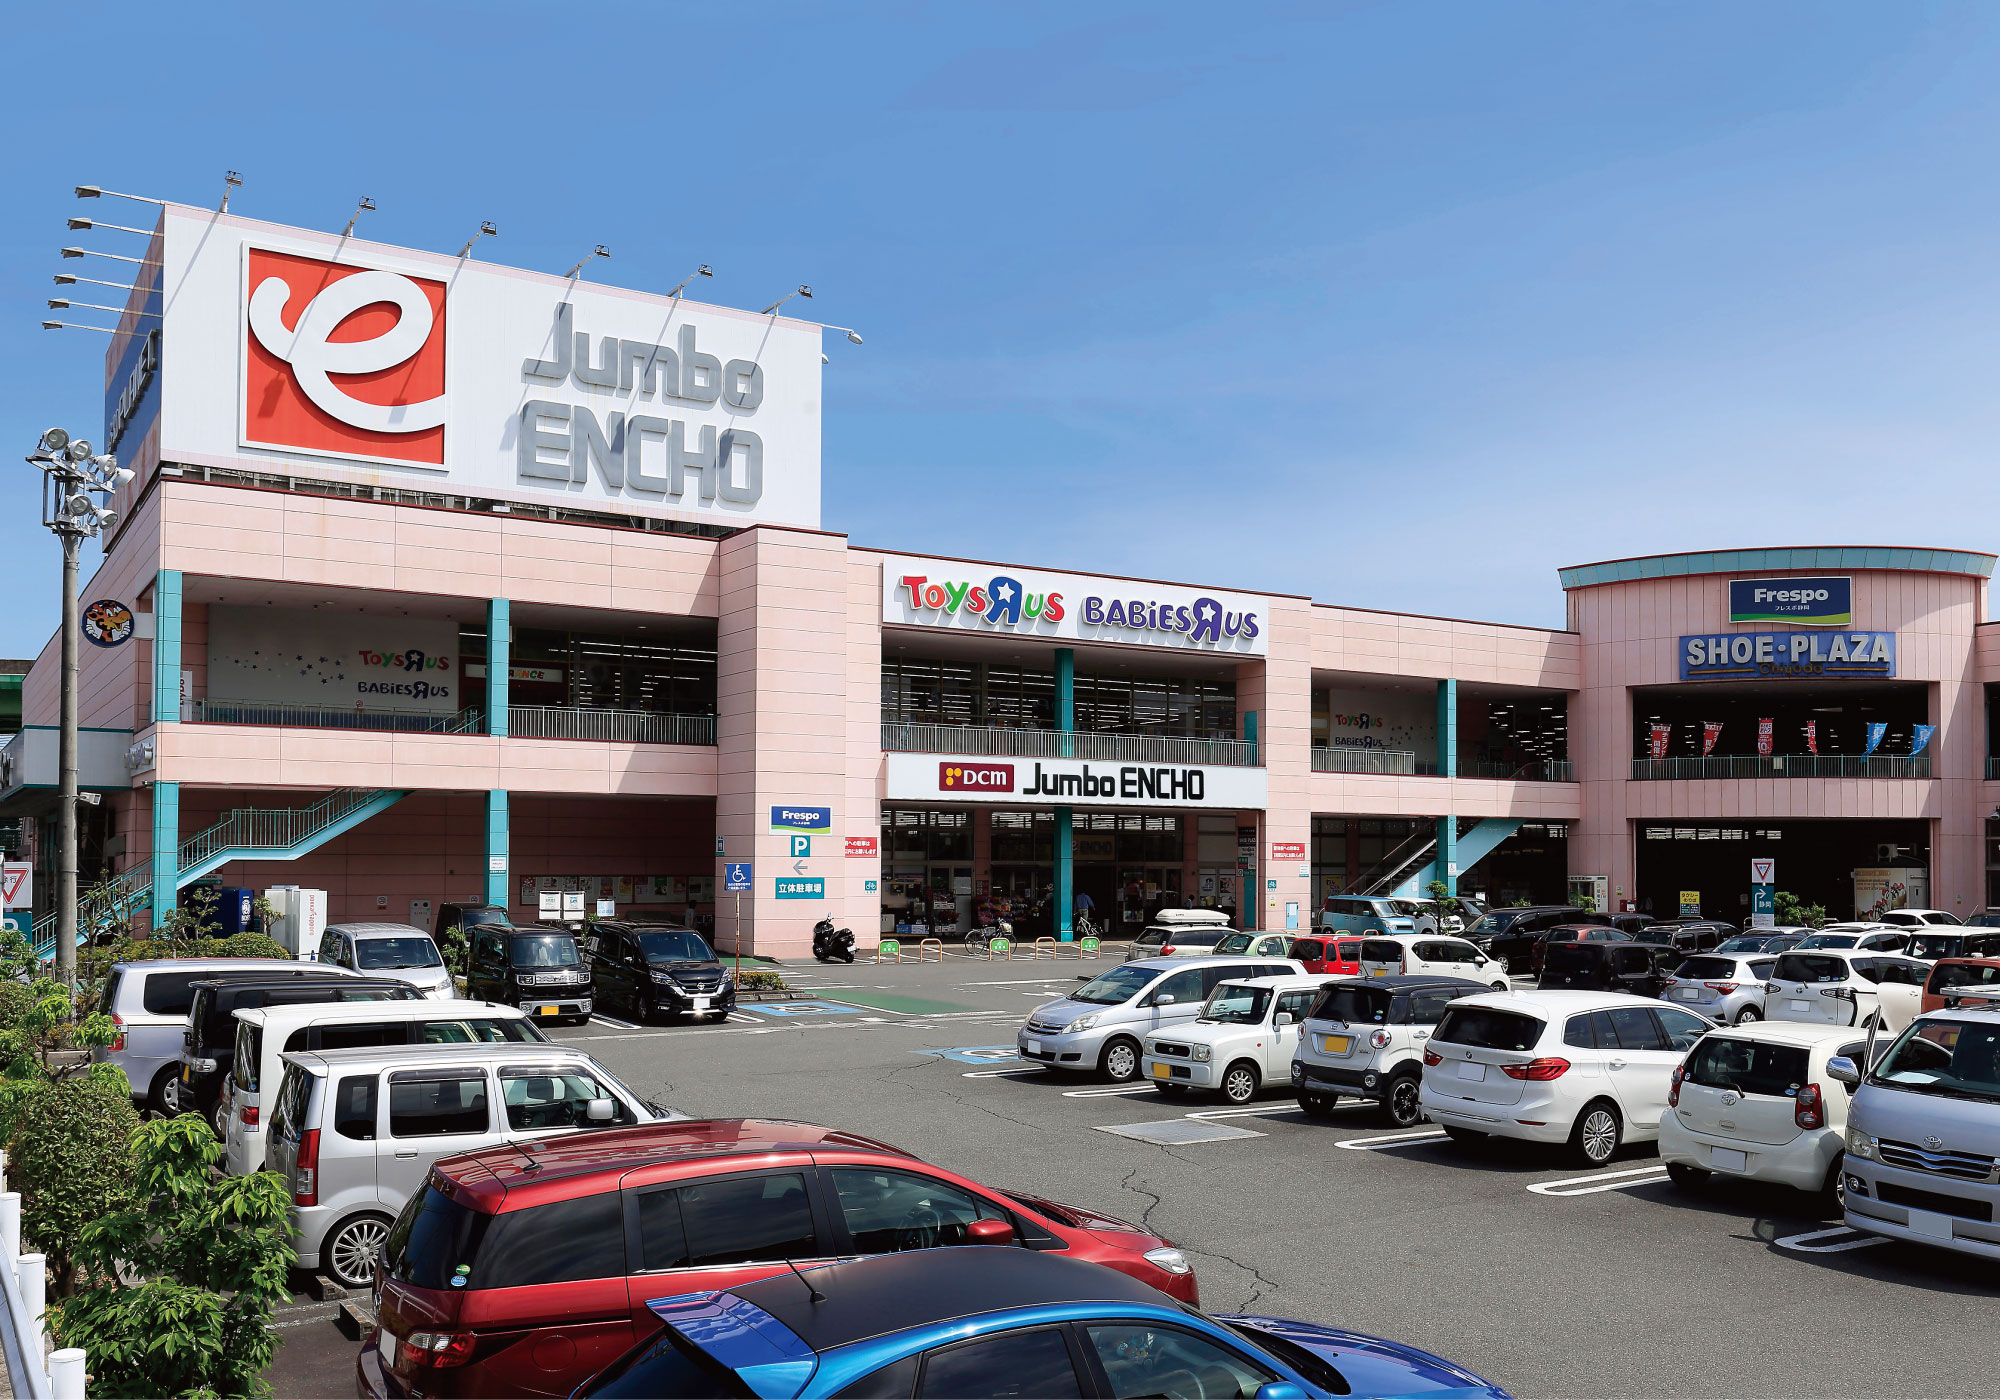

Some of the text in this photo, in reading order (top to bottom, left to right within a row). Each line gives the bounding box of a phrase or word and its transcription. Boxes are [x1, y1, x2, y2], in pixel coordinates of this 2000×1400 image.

[521, 301, 764, 409] Jumbo
[520, 400, 764, 504] ENCHO
[1754, 588, 1829, 603] Frespo
[1023, 762, 1205, 801] Jumbo ENCHO
[782, 811, 820, 821] Frespo
[794, 837, 808, 856] P
[778, 883, 822, 893] 立体駐車場
